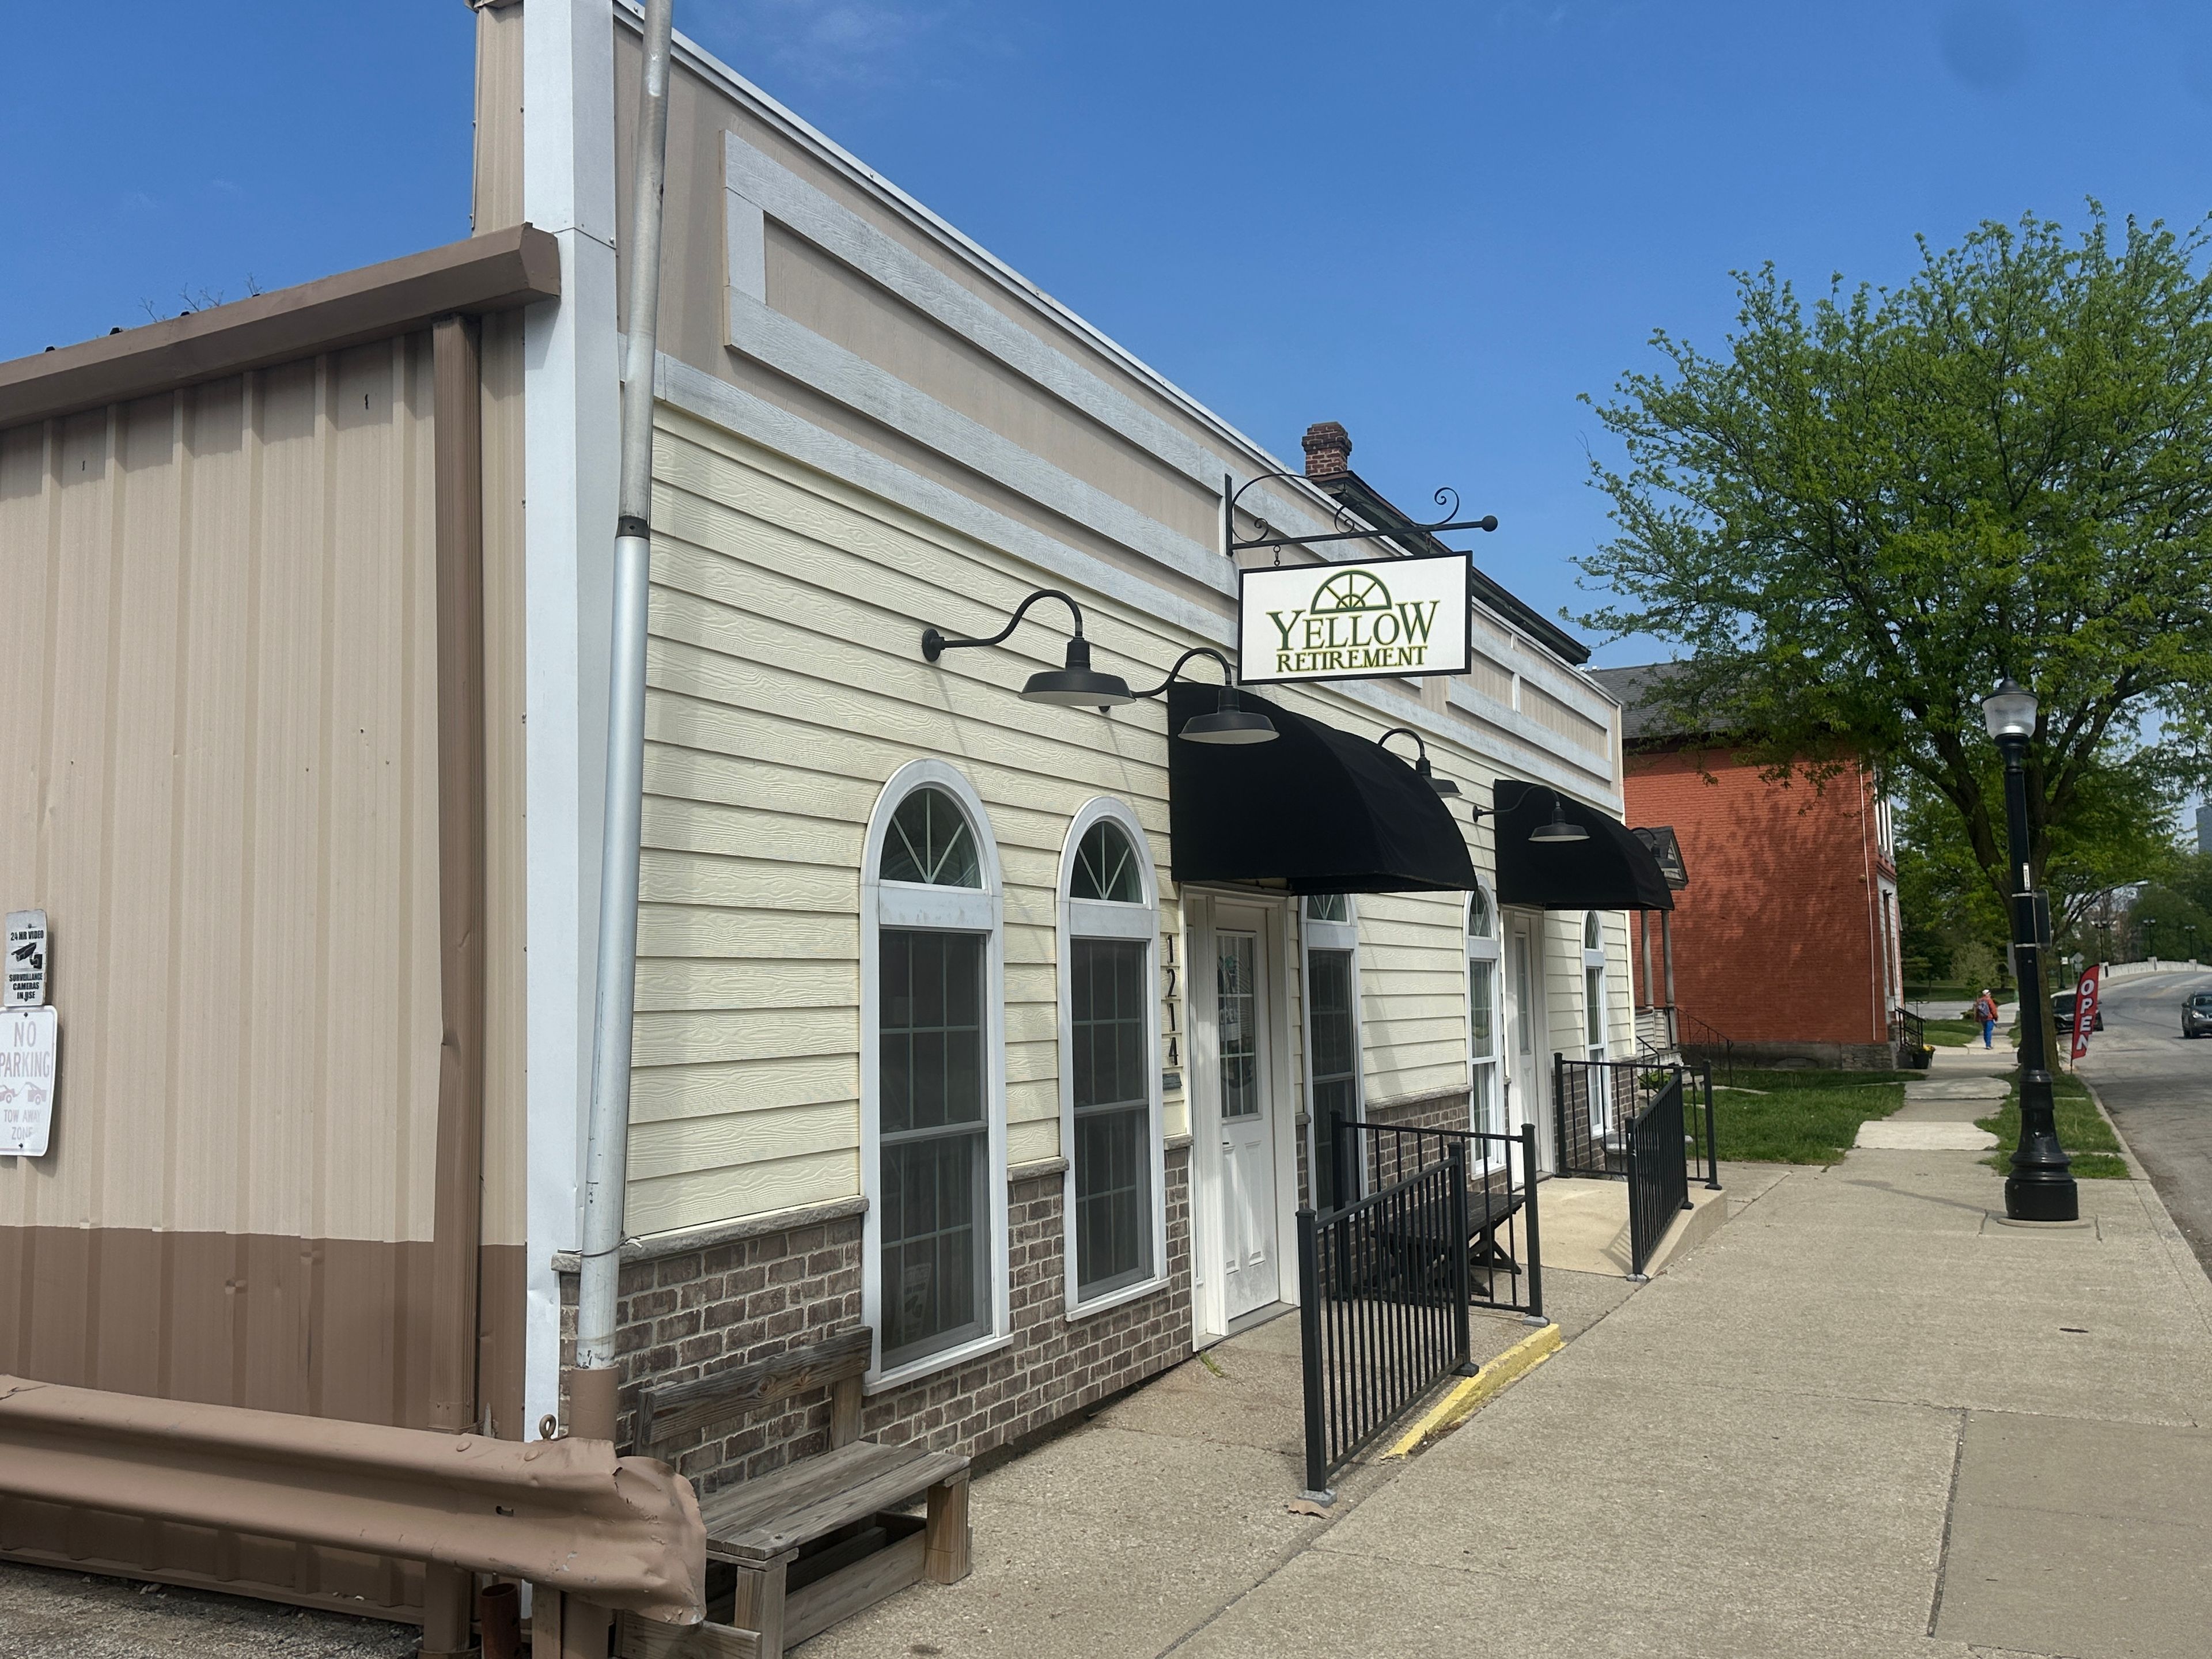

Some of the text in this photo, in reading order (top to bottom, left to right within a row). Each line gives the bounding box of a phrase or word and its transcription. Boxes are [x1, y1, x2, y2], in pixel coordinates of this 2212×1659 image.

[1266, 600, 1440, 652] YELLOW
[1276, 645, 1429, 673] RETIREMENT
[10, 930, 44, 941] 24 HR VIDEO
[9, 972, 43, 982] SURVEILLANCE
[13, 982, 40, 991] CAMERAS
[17, 991, 36, 1000] IN USE
[1166, 934, 1179, 1066] 1214
[2076, 979, 2095, 1051] OPEN
[14, 1021, 36, 1047] NO
[4, 1109, 42, 1123] TOW AWAY
